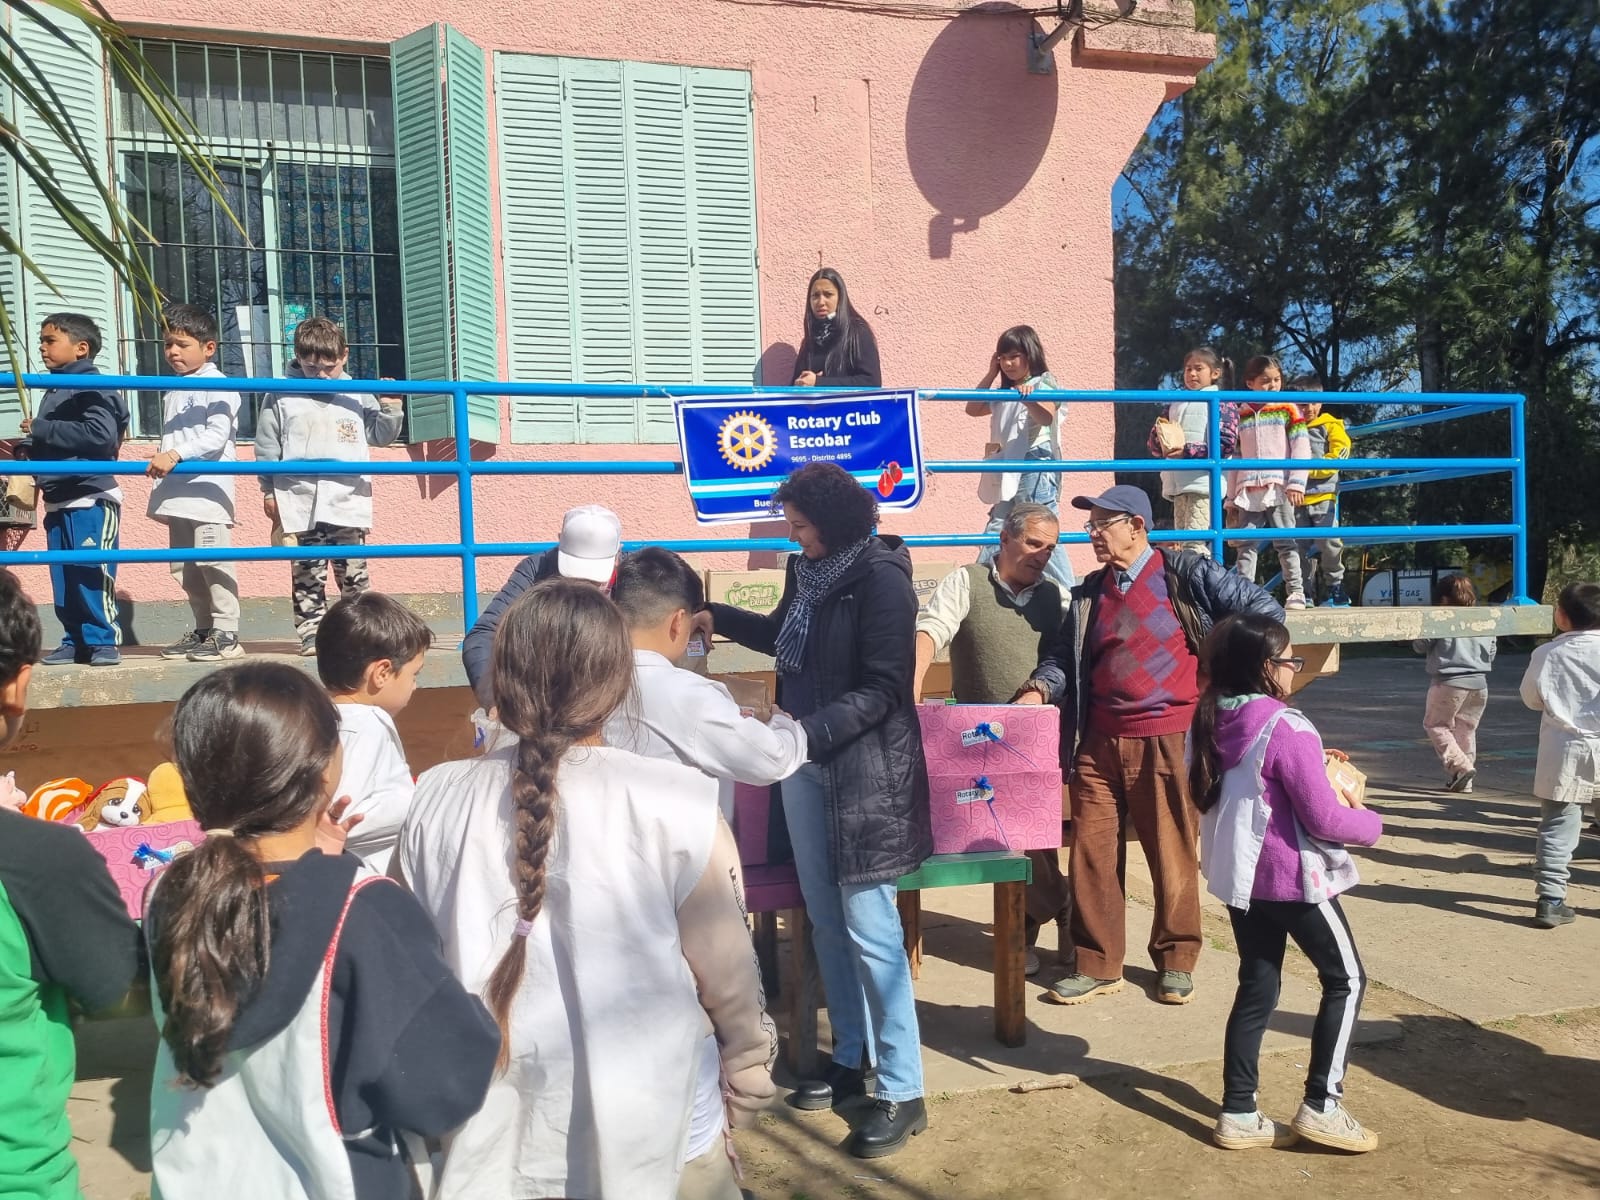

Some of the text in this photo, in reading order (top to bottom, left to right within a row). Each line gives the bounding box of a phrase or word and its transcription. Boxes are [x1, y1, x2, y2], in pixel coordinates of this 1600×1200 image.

[787, 411, 881, 431] Rotary Club
[789, 433, 852, 449] Escobar
[811, 454, 836, 462] Distrito
[957, 790, 979, 798] Rotary
